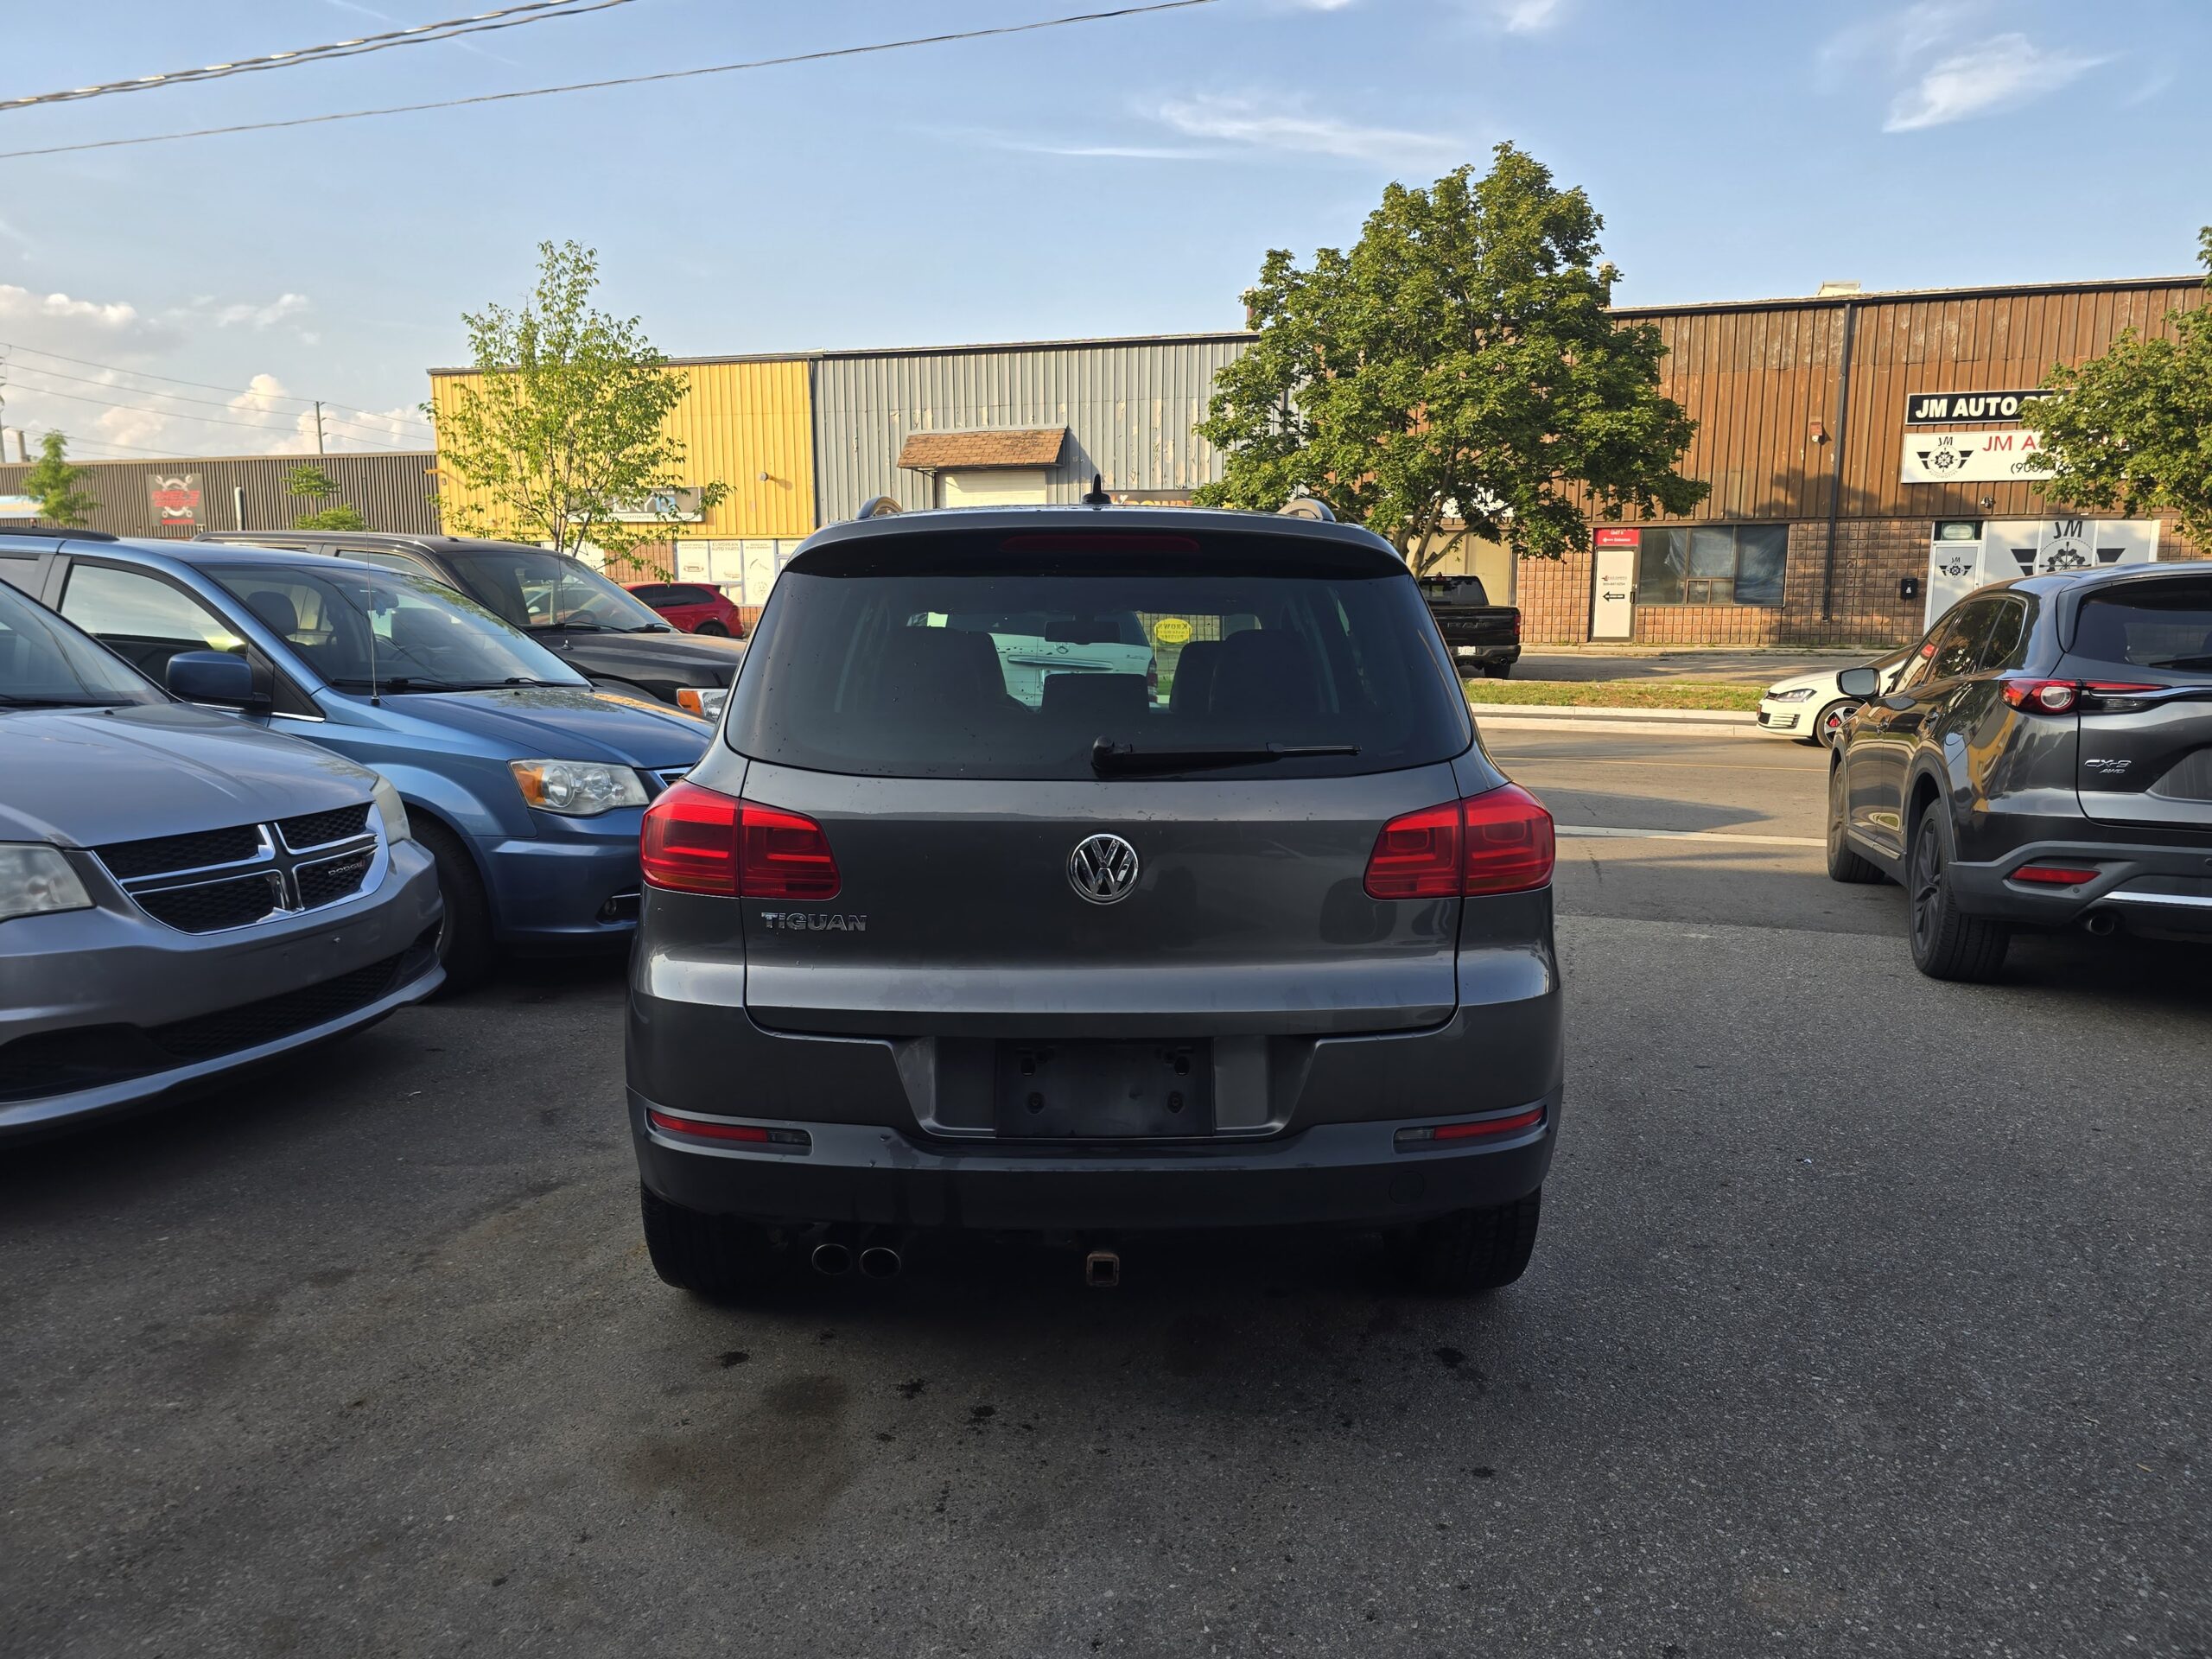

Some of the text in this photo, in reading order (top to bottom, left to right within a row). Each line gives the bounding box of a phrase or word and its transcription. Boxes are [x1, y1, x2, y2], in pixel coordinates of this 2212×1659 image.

[1915, 398, 1948, 419] JM
[1951, 396, 2018, 417] AUTO
[1937, 435, 1954, 447] JM
[1982, 435, 2013, 452] JM
[2053, 518, 2083, 539] JM
